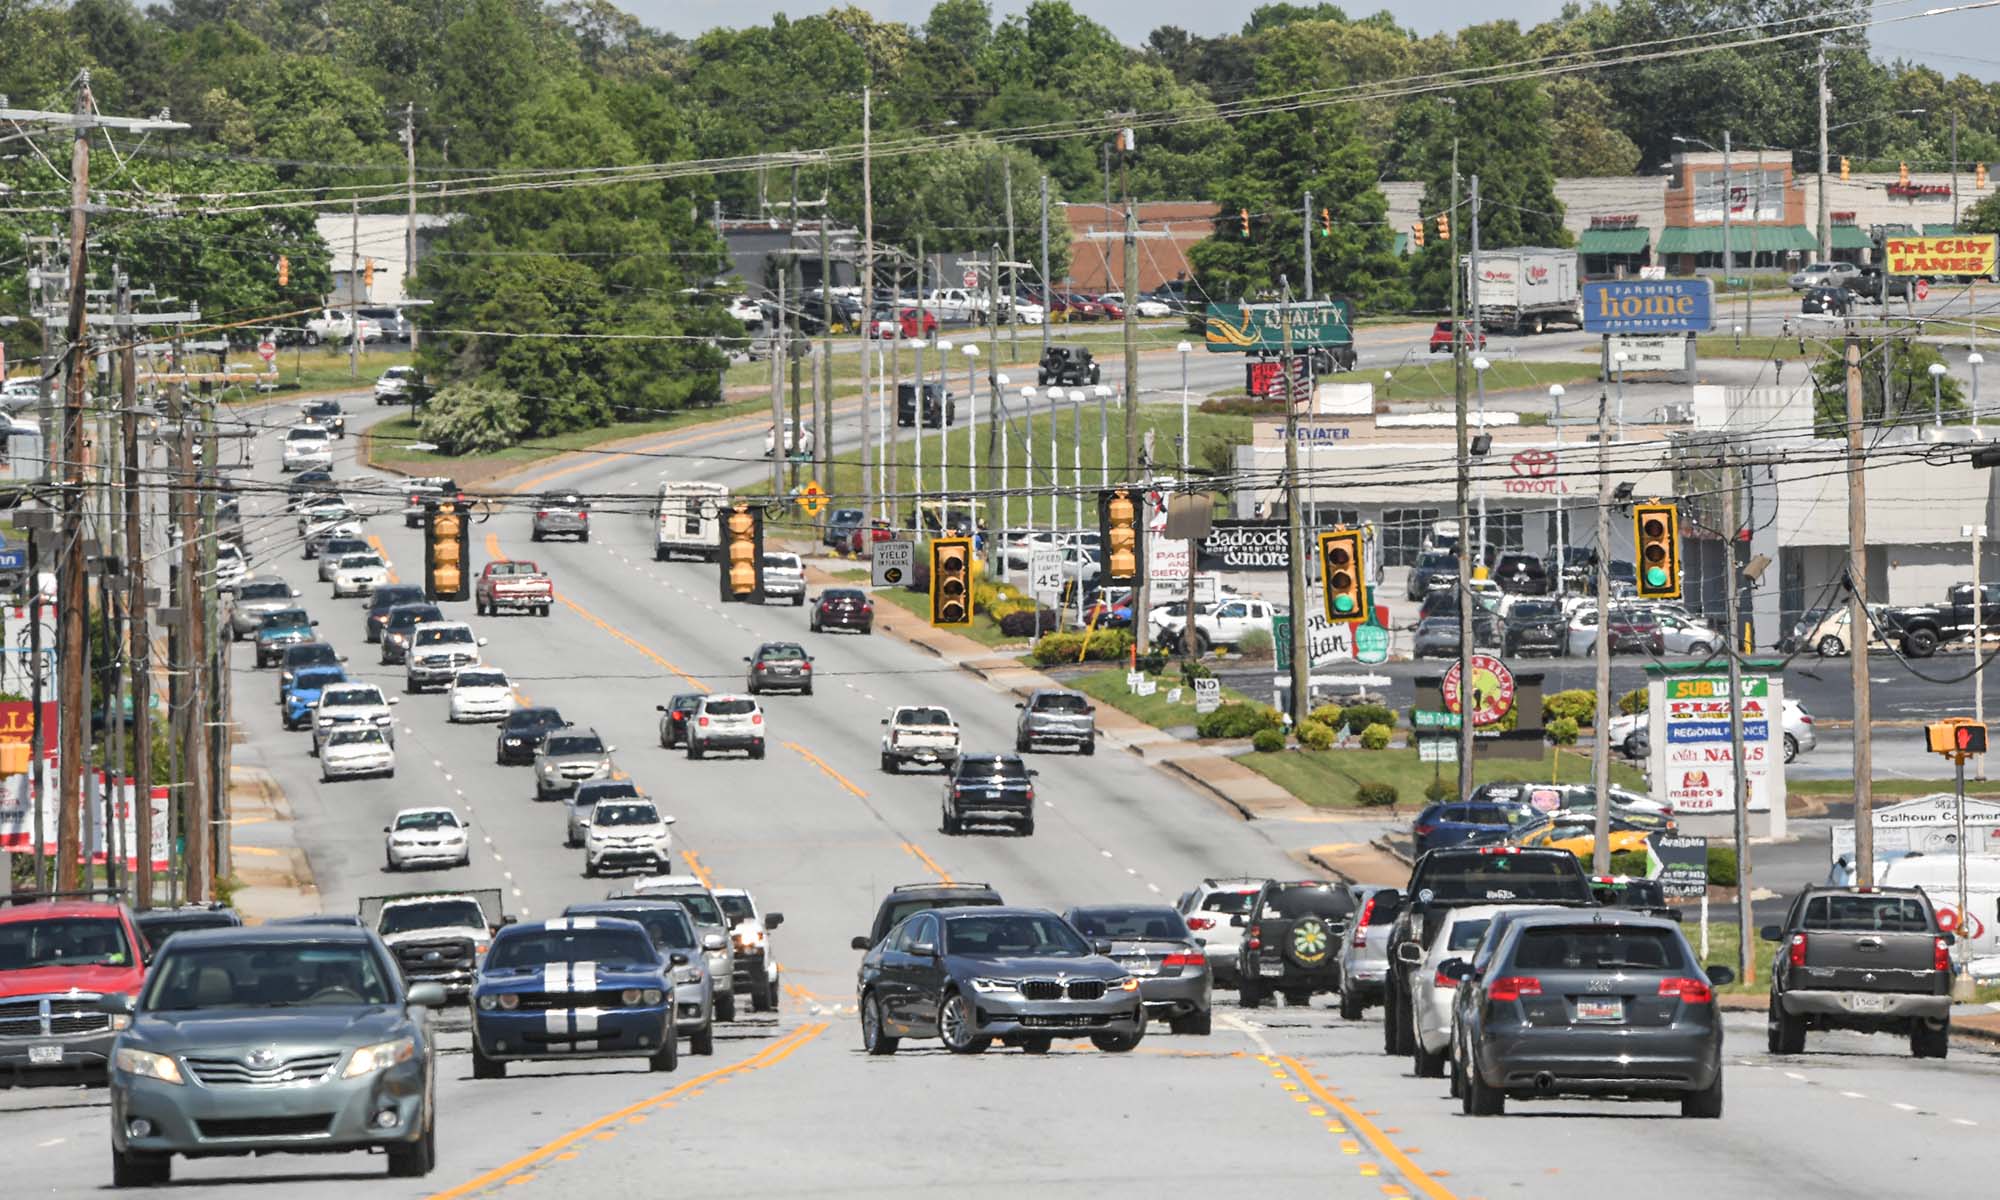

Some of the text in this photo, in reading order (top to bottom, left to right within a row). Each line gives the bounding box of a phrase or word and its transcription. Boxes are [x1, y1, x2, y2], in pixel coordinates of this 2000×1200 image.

[1887, 240, 1991, 254] Tri-City
[1894, 257, 1983, 271] LANES
[1599, 288, 1694, 317] home
[1275, 427, 1349, 440] TEWATER
[1204, 526, 1288, 546] Badcock
[880, 551, 908, 559] YIELD
[1156, 551, 1190, 559] PAR
[1224, 545, 1289, 566] &more
[1037, 573, 1060, 588] 45
[1197, 681, 1216, 689] NO
[1676, 680, 1759, 698] SUBWY
[1674, 726, 1767, 737] REGIONAL FNCE
[1704, 747, 1764, 761] NALS
[1880, 813, 1936, 823] Calhoun
